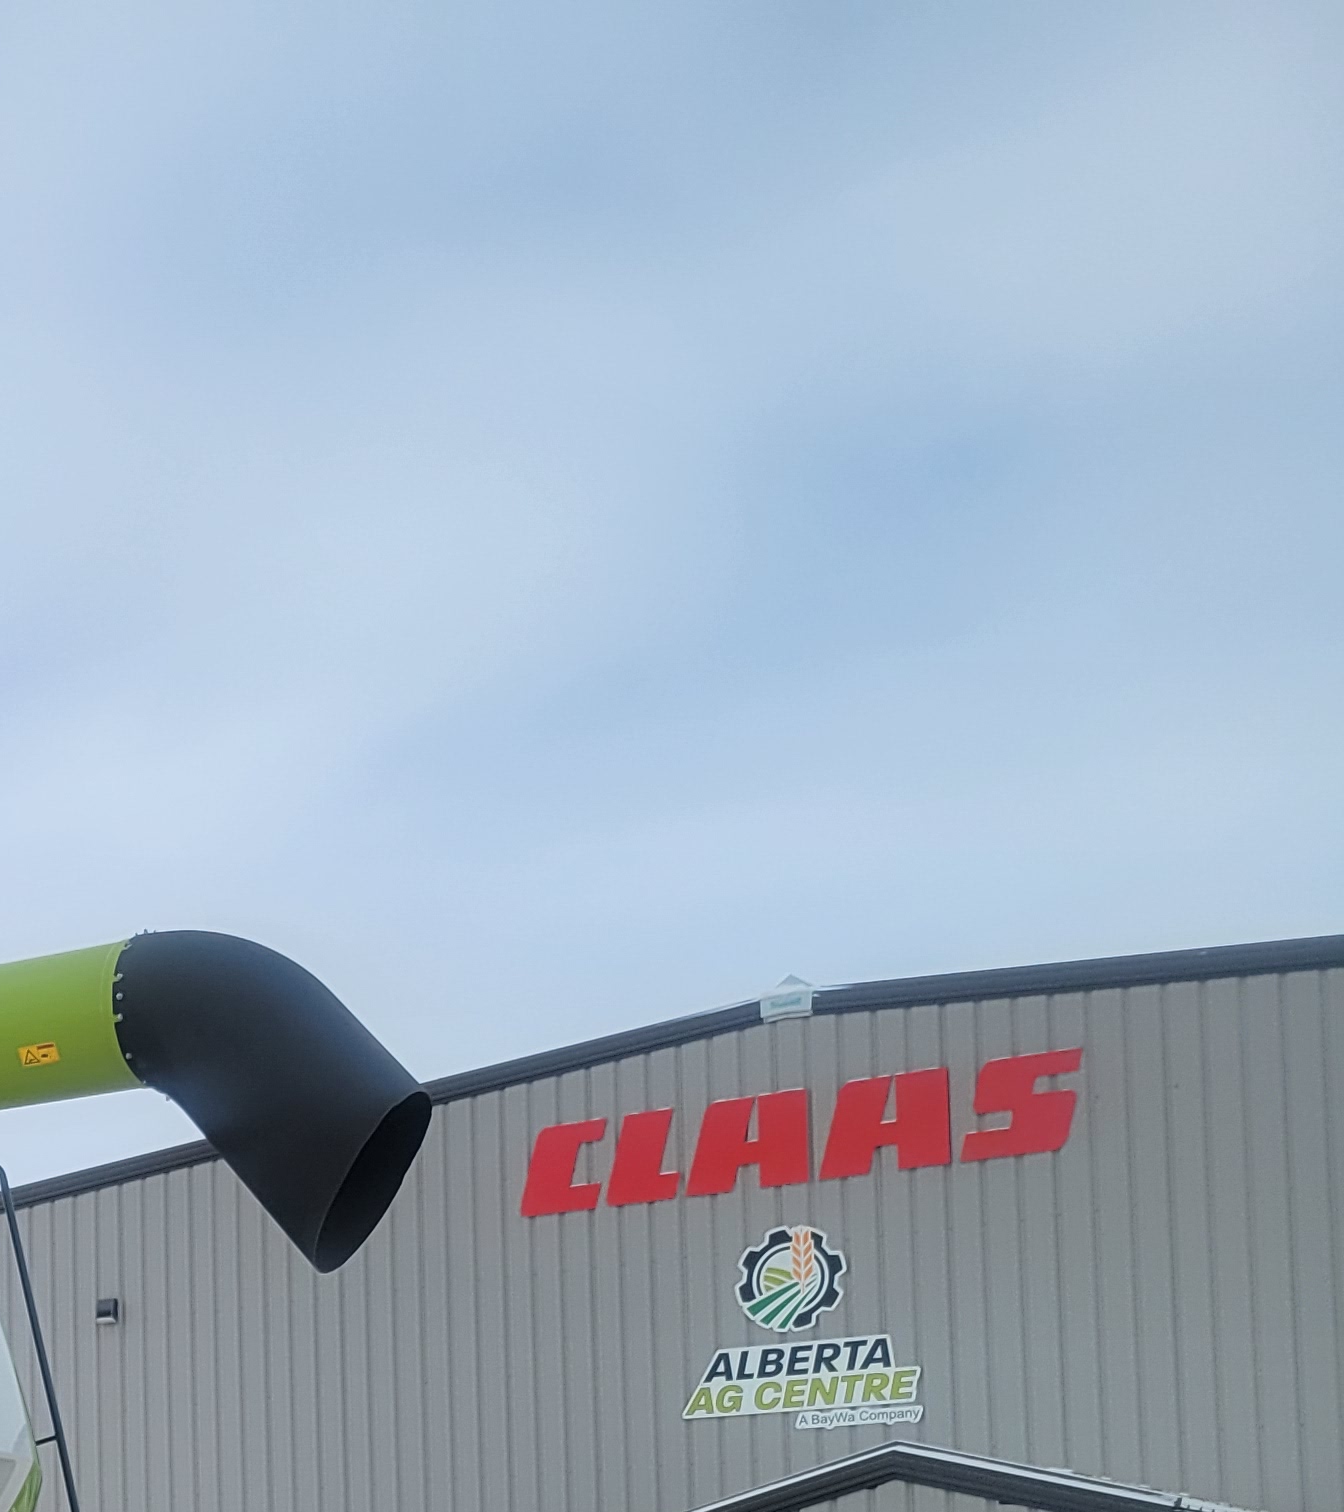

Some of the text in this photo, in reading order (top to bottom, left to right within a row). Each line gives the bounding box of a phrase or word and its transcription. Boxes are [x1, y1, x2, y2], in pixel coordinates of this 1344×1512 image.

[520, 1047, 1084, 1218] CLAAS
[703, 1336, 893, 1384] ALBERTA
[684, 1368, 918, 1416] AG CENTRE
[798, 1407, 921, 1429] A BayWa Company
